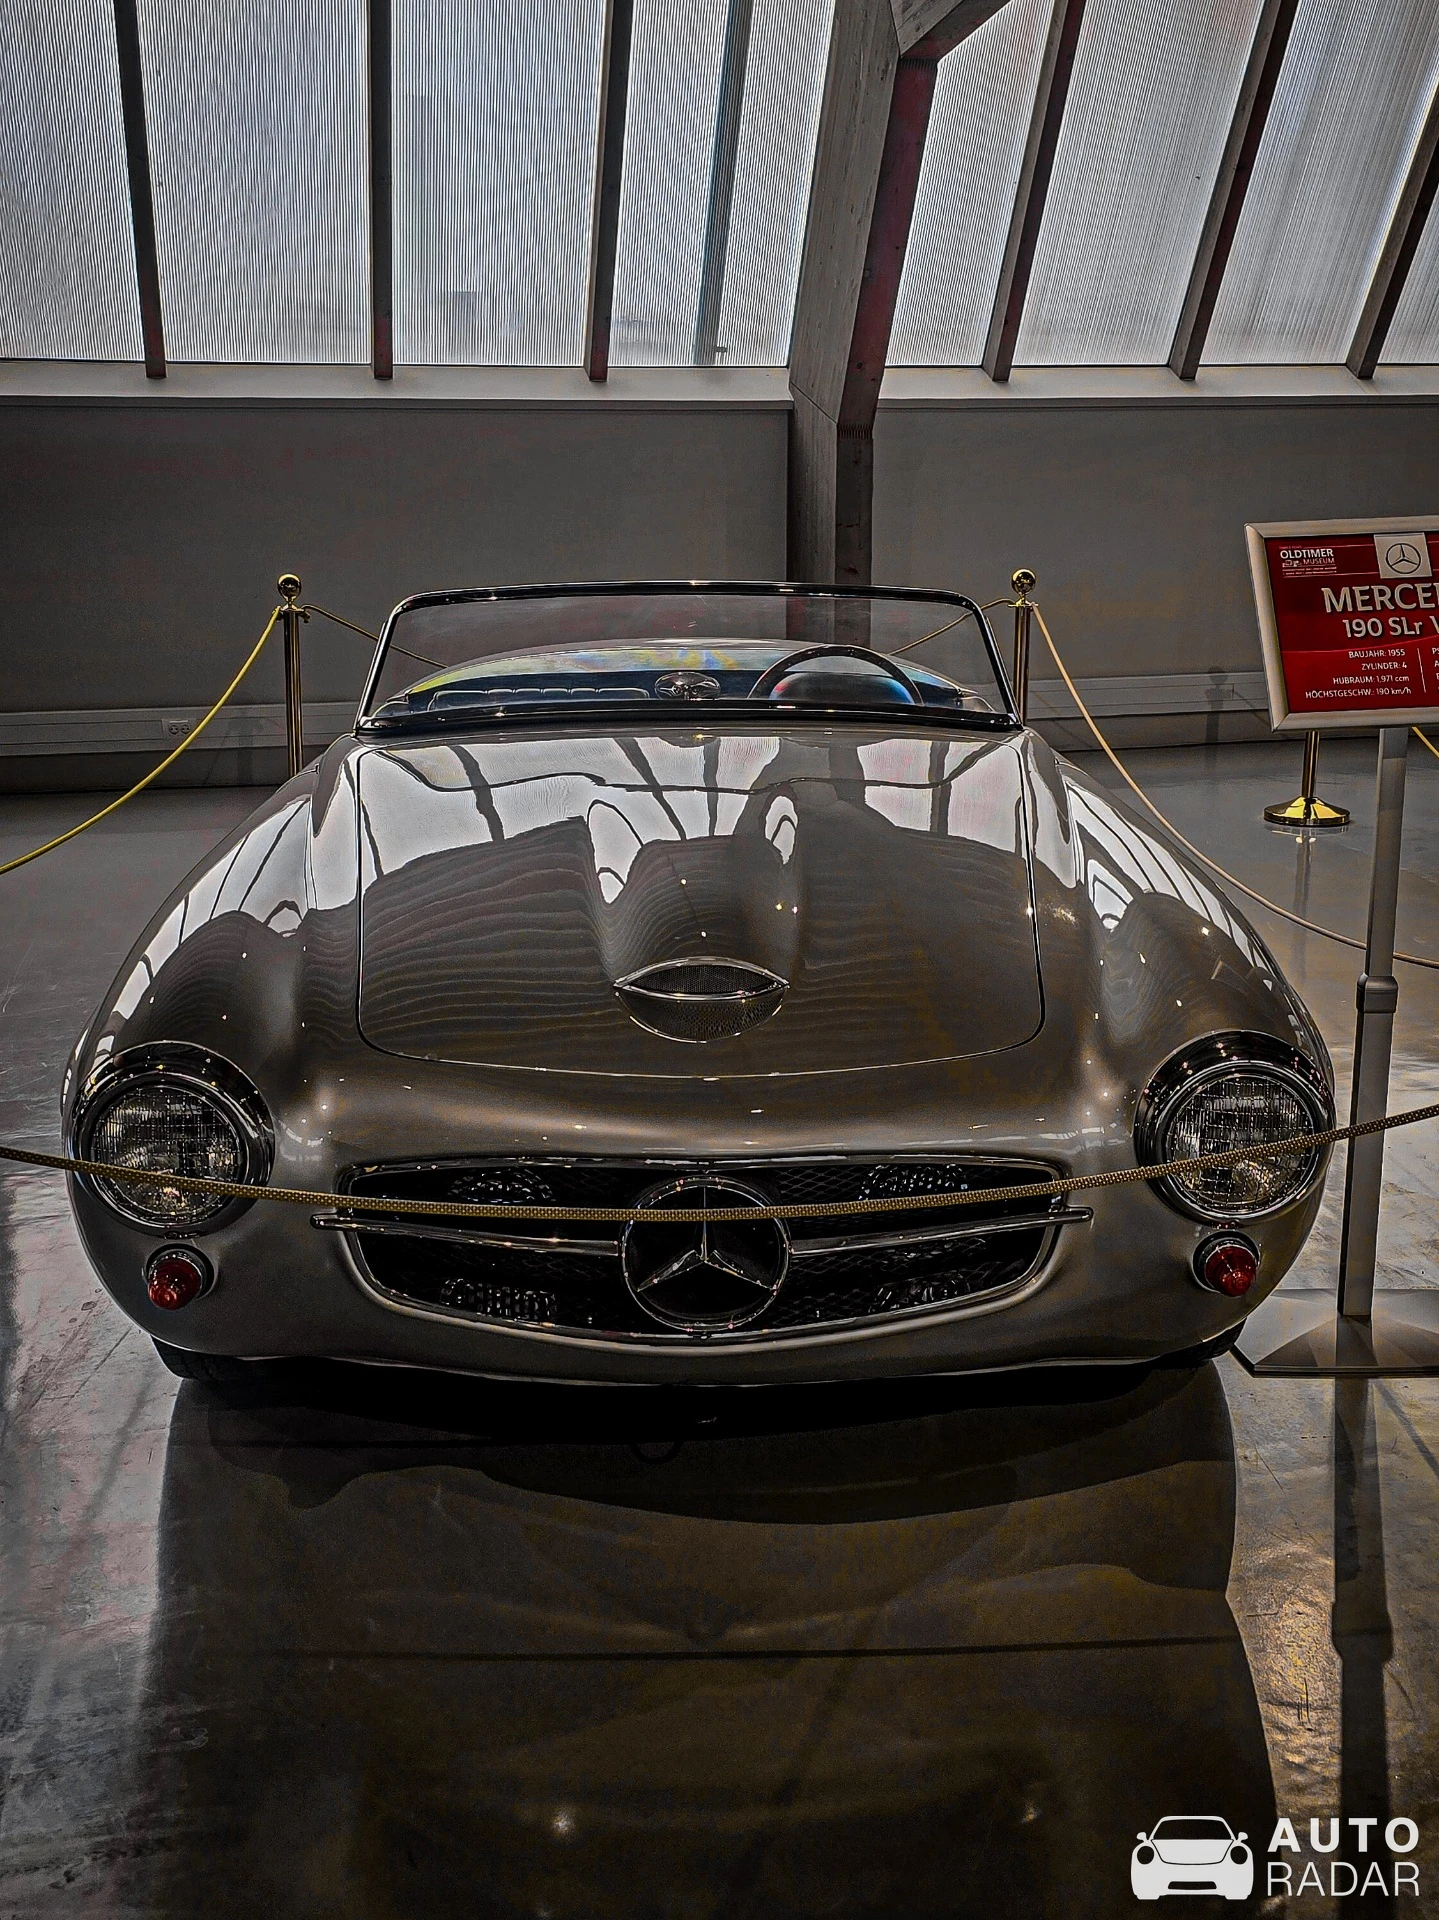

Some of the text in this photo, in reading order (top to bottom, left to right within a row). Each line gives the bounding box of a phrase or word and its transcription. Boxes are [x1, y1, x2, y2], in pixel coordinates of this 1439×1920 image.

[1280, 548, 1334, 559] OLDTIMER
[1303, 557, 1335, 565] MUSEUM
[1342, 617, 1383, 638] 190
[1388, 616, 1423, 636] SLr
[1348, 648, 1406, 659] BAUJAHR: 1955
[1361, 661, 1408, 671] ZYLINDER: 4
[1332, 675, 1376, 685] HUBRAUM:
[1376, 687, 1390, 696] 190
[1390, 686, 1412, 695] km/h
